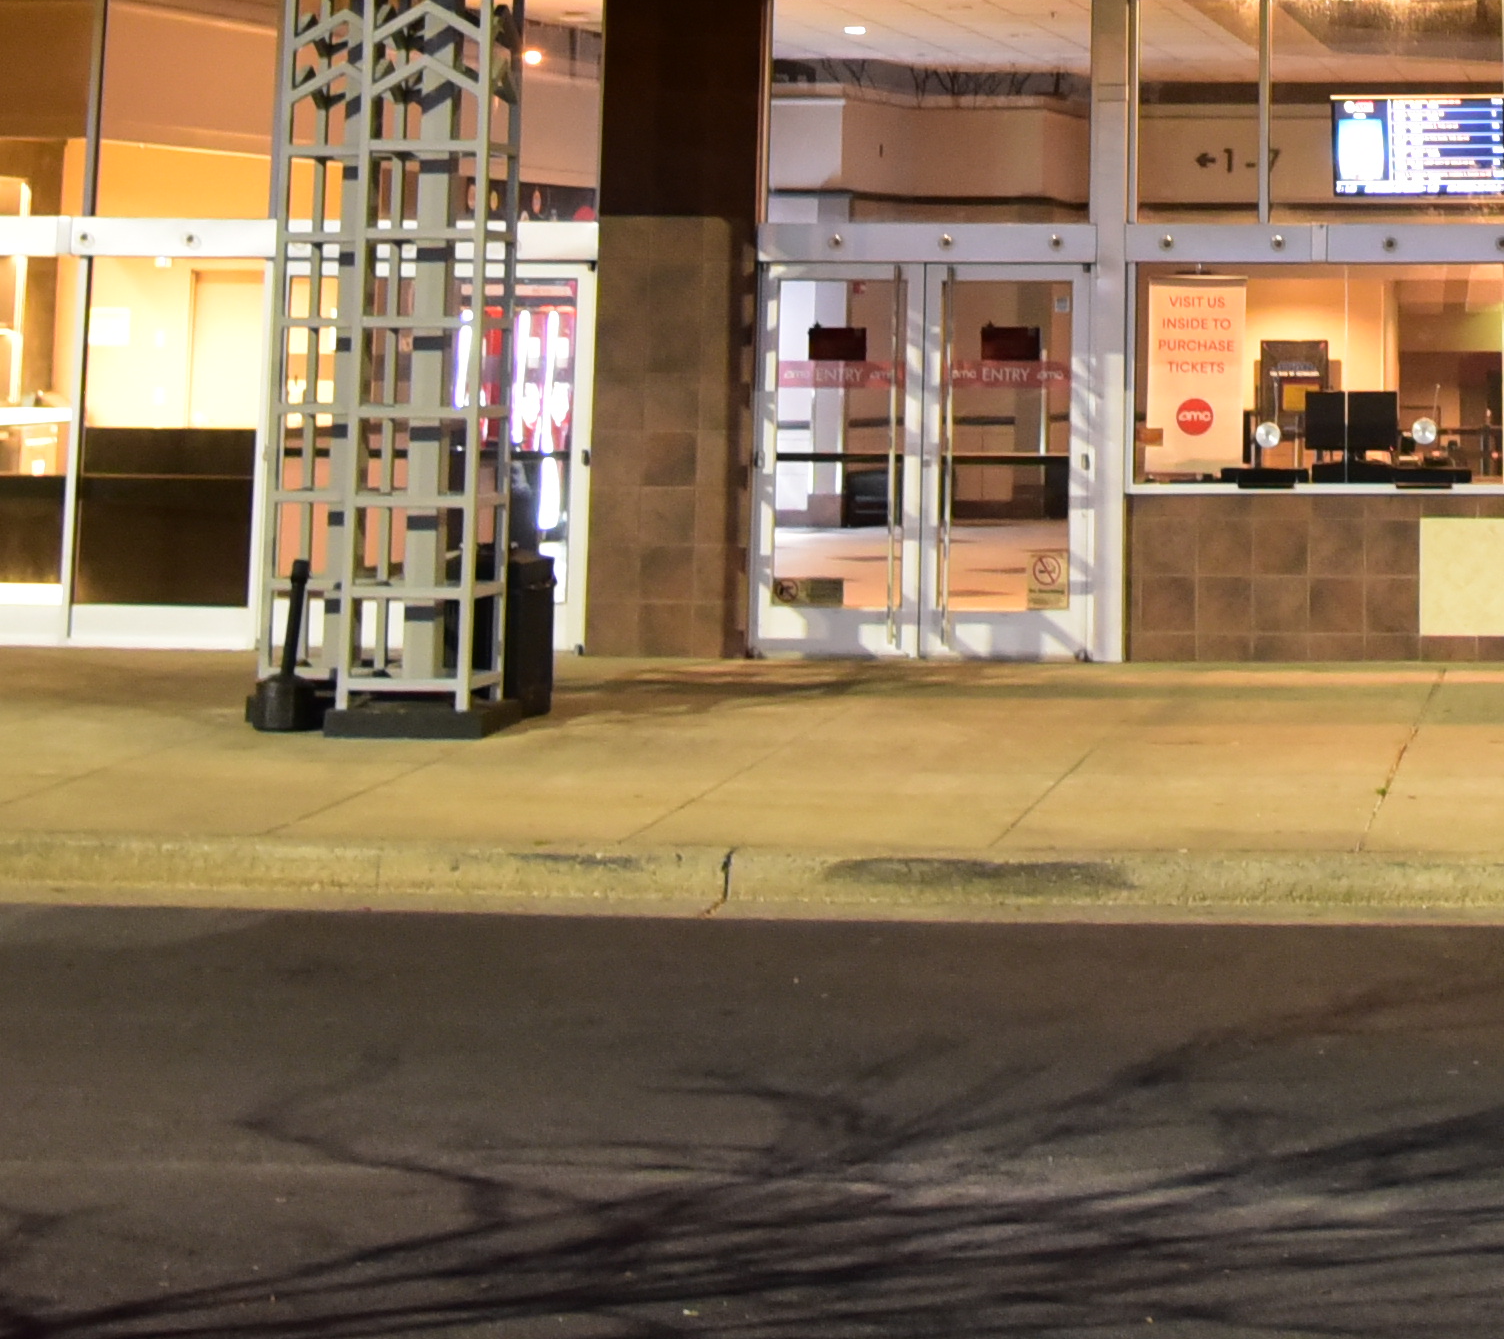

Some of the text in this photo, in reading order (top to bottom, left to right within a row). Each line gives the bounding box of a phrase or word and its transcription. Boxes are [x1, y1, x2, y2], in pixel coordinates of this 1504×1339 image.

[1169, 296, 1226, 308] VISIT US
[1162, 318, 1231, 331] INSIDE TO
[1158, 339, 1235, 352] PURCHASE
[1167, 361, 1225, 373] TICKETS
[816, 368, 863, 382] ENTRY
[982, 367, 1030, 382] ENTRY
[1037, 370, 1064, 380] amc
[1178, 410, 1212, 421] amc
